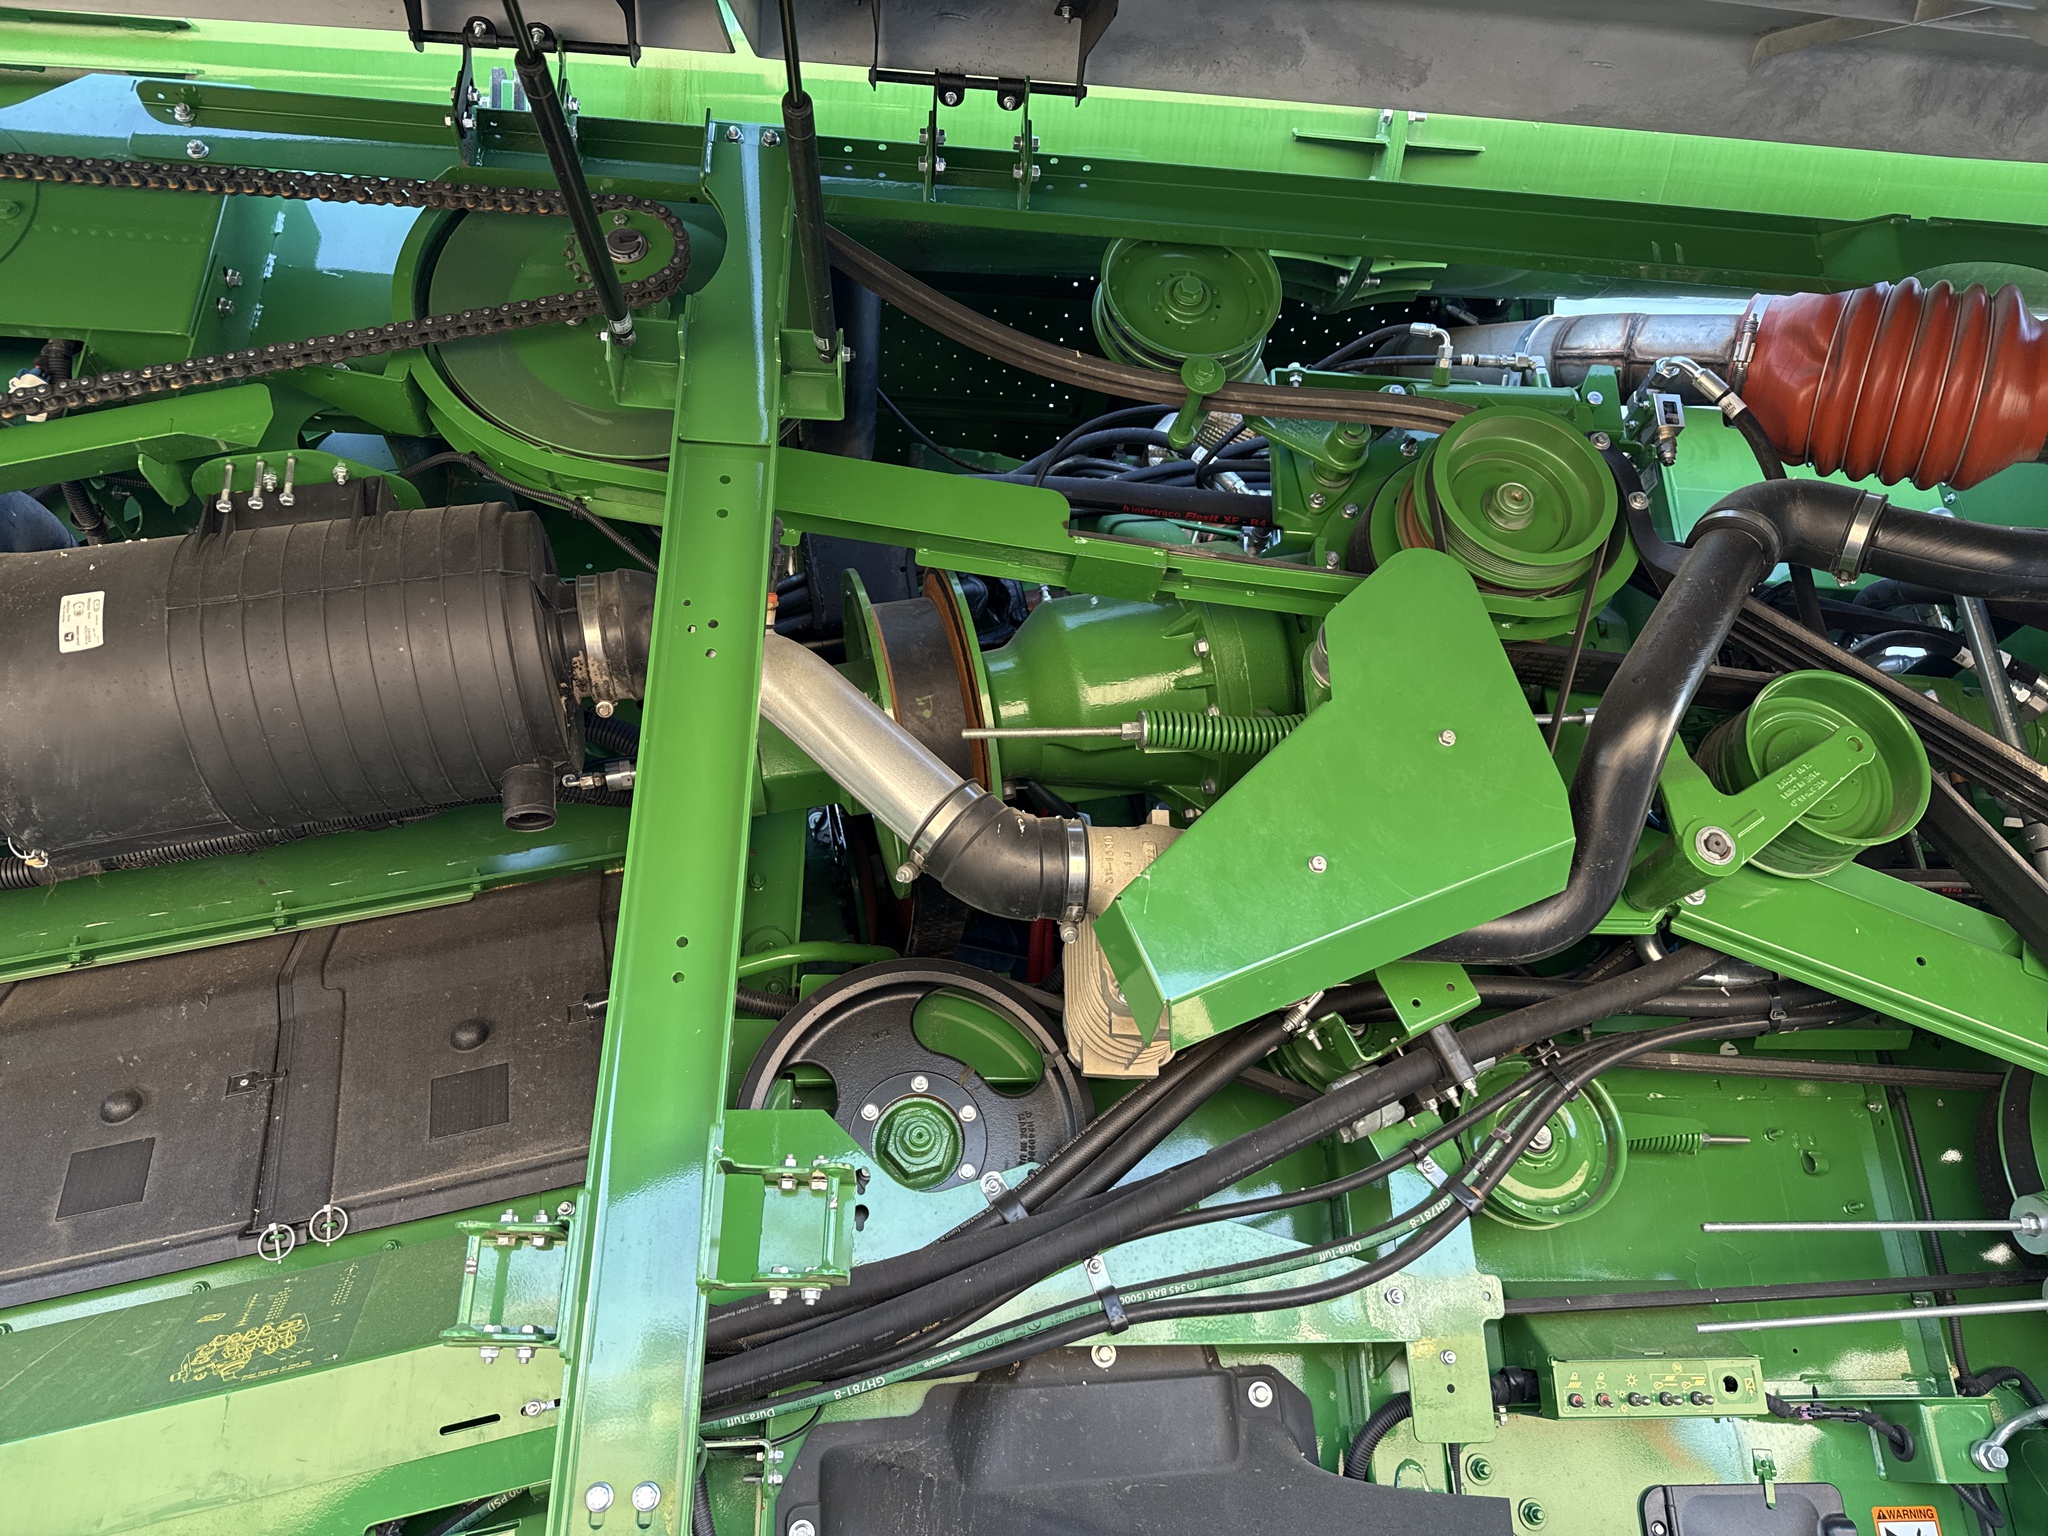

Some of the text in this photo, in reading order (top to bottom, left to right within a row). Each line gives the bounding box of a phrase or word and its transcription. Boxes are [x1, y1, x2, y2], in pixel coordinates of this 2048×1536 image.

[1132, 505, 1181, 518] intertraco
[1185, 511, 1220, 522] Flexit
[1223, 515, 1240, 524] XF
[1250, 518, 1267, 526] R4
[1081, 1119, 1098, 1134] Flame
[1097, 1100, 1123, 1121] Resistant
[1407, 1195, 1452, 1227] GH781-8
[1316, 1241, 1362, 1262] Dura-Tuff
[1146, 1287, 1167, 1298] BAR
[1168, 1283, 1187, 1293] 345
[782, 1361, 808, 1373] Engineered
[922, 1352, 952, 1369] Aeroquip
[892, 1366, 916, 1379] Danfoss
[833, 1376, 886, 1399] GH781-8
[796, 1397, 811, 1405] DN12
[725, 1407, 775, 1427] Dura-Tuff
[487, 1494, 508, 1512] PSI)
[1886, 1508, 1934, 1520] WARNING
